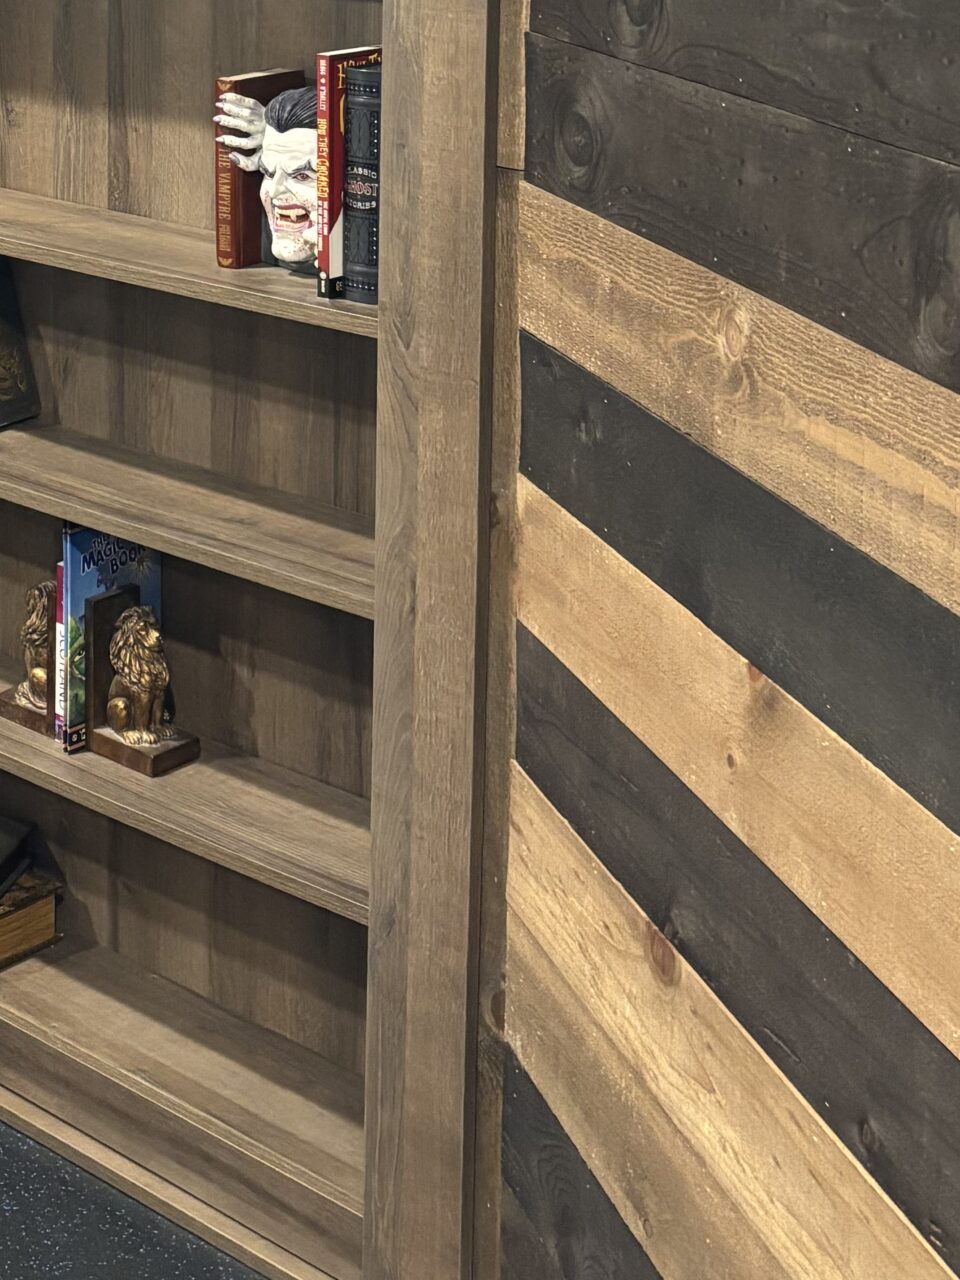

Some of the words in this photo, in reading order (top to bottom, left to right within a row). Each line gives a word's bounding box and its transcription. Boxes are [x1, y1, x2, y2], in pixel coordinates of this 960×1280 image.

[317, 118, 328, 135] HOW
[318, 137, 329, 157] THEY
[316, 158, 330, 198] CROAKED
[218, 173, 232, 220] VAMPYRE
